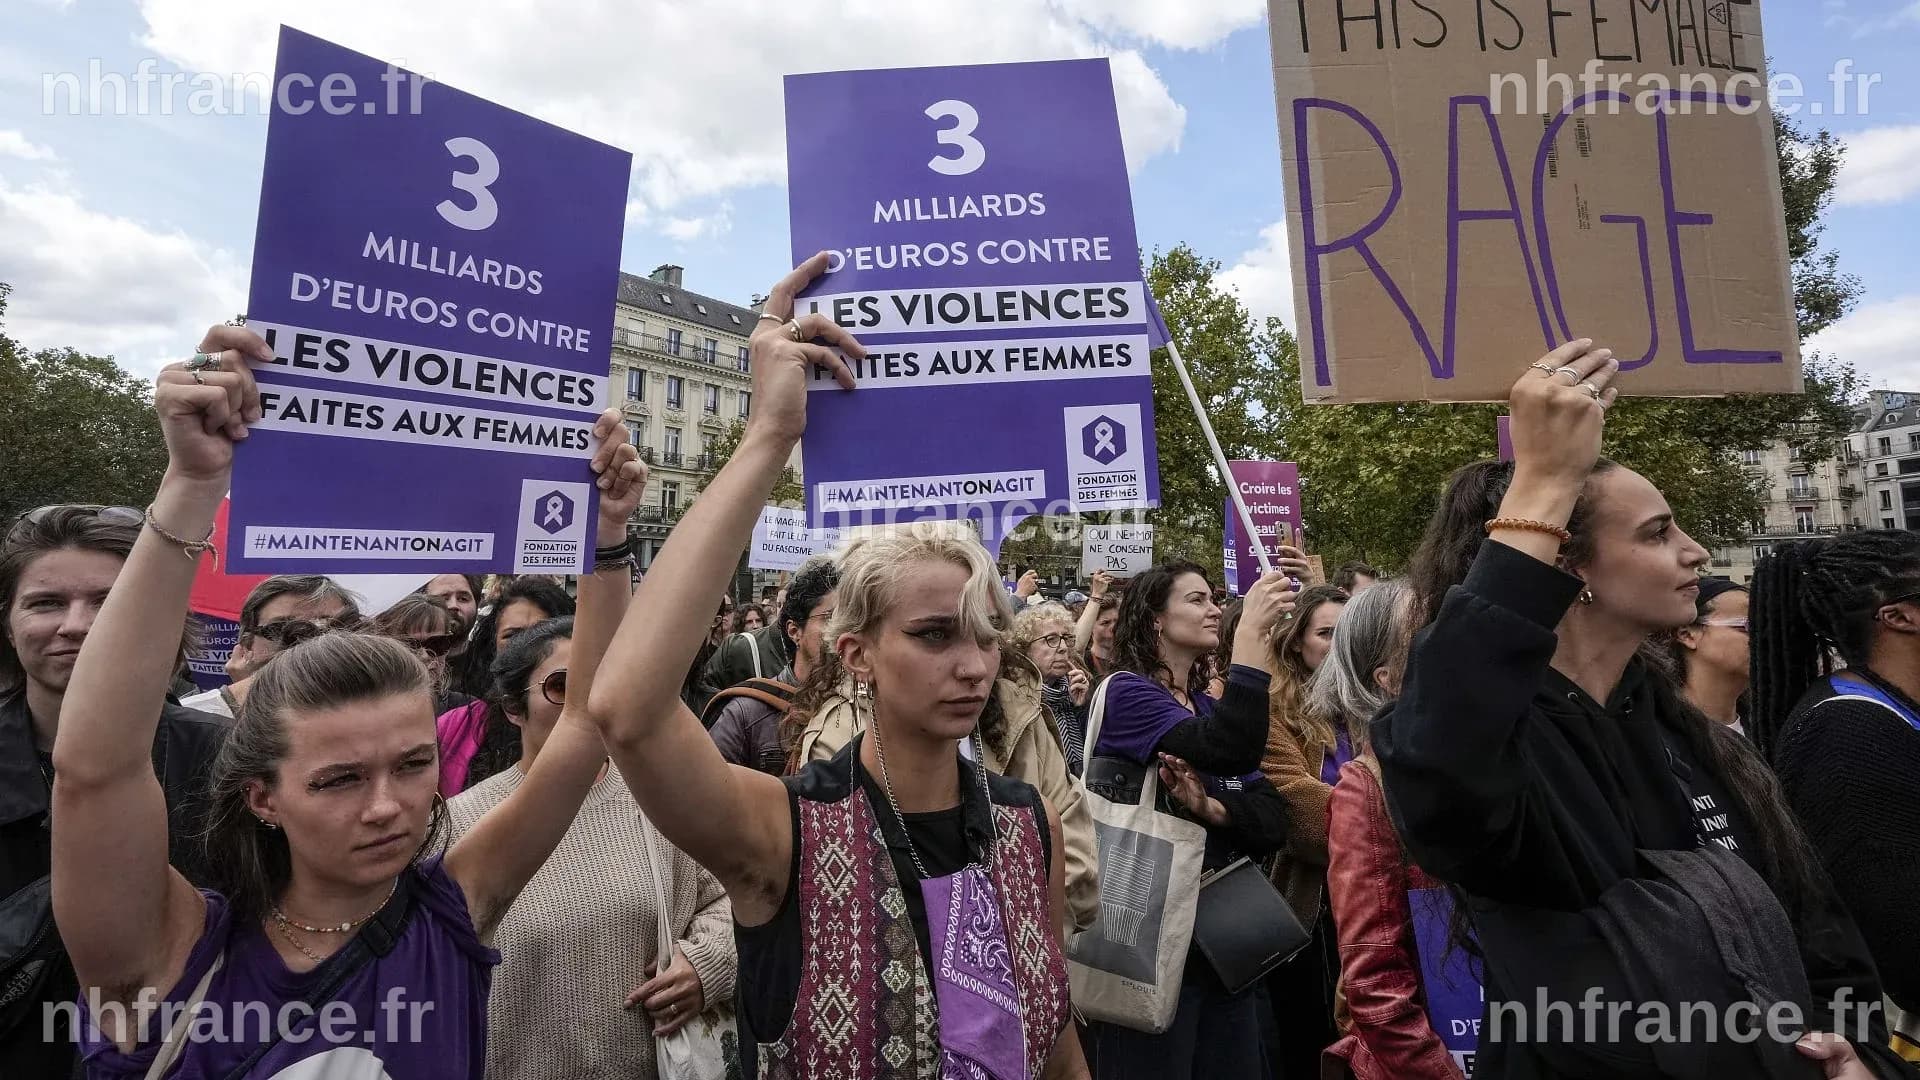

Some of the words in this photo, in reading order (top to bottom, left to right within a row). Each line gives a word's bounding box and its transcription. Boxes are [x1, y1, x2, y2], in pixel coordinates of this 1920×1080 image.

[1475, 0, 1523, 50] IS
[1549, 0, 1757, 73] FEMALE
[923, 98, 986, 176] 3
[436, 137, 500, 230] 3
[874, 192, 1046, 223] MILLIARDS
[977, 237, 1111, 265] CONTRE
[1293, 89, 1782, 386] RAGE
[362, 232, 543, 294] MILLIARDS
[891, 287, 1129, 326] VIOLENCES
[467, 307, 591, 352] CONTRE
[265, 329, 350, 373] LES
[364, 343, 595, 407] VIOLENCES
[929, 349, 996, 376] AUX
[1005, 343, 1132, 372] FEMMES
[260, 392, 384, 430] FAITES
[392, 409, 465, 439] AUX
[473, 417, 589, 451] FEMMES
[826, 476, 1035, 504] #MAINTENANTONAGIT
[1077, 474, 1136, 485] FONDATION
[1240, 482, 1275, 495] Croire
[1278, 482, 1292, 495] les
[1079, 491, 1096, 500] DES
[1100, 488, 1137, 498] FEMMES
[1245, 502, 1290, 514] victimes
[254, 534, 485, 553] #MAINTENANTONAGIT
[524, 543, 577, 551] FONDATION
[770, 530, 786, 540] FAIT
[787, 531, 796, 540] LE
[797, 531, 809, 541] LIT
[1089, 528, 1109, 541] QUI
[523, 556, 539, 564] DES
[542, 556, 575, 564] FEMMES
[762, 543, 774, 552] DU
[775, 544, 813, 556] FASCISME
[1089, 544, 1103, 553] NE
[1109, 544, 1153, 554] CONSENT
[1105, 556, 1128, 569] PAS
